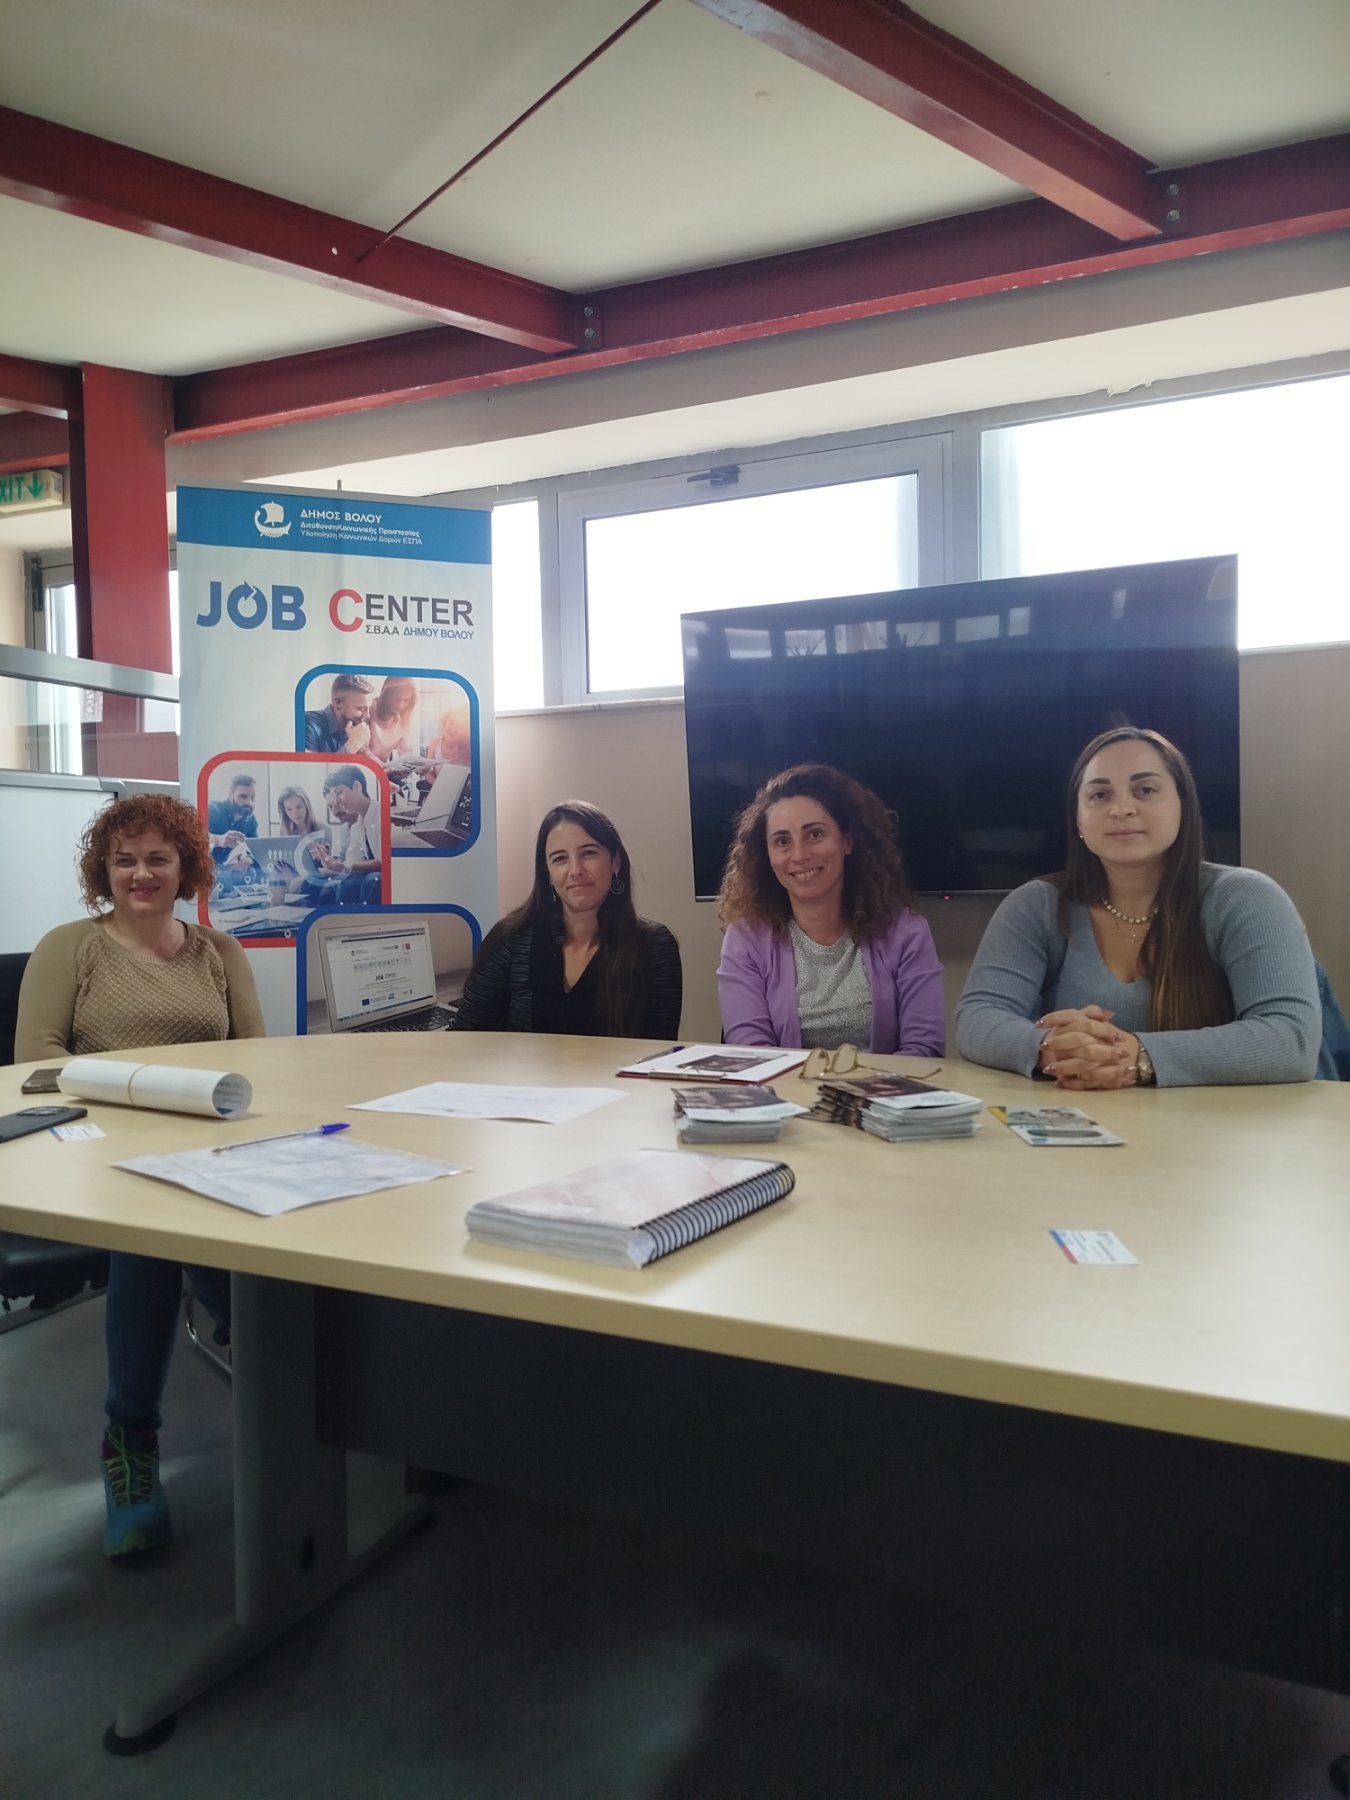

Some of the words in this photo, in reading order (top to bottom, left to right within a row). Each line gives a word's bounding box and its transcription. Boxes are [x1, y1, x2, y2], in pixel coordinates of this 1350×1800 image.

[0, 476, 24, 502] XIT
[300, 509, 341, 521] ΔΗΜΟΣ
[345, 512, 382, 524] ΒΟΛΟΥ
[301, 530, 338, 540] Υλοποίηση
[338, 533, 378, 542] Κοινωνικών
[378, 535, 402, 544] Δομών
[402, 537, 423, 545] ΕΣΠΑ
[378, 527, 420, 538] Προστασίας
[196, 580, 307, 631] JOB
[328, 588, 474, 633] CENTER
[403, 627, 439, 638] ΔΗΜΟΥ
[440, 629, 475, 640] ΒΟΛΟΥ
